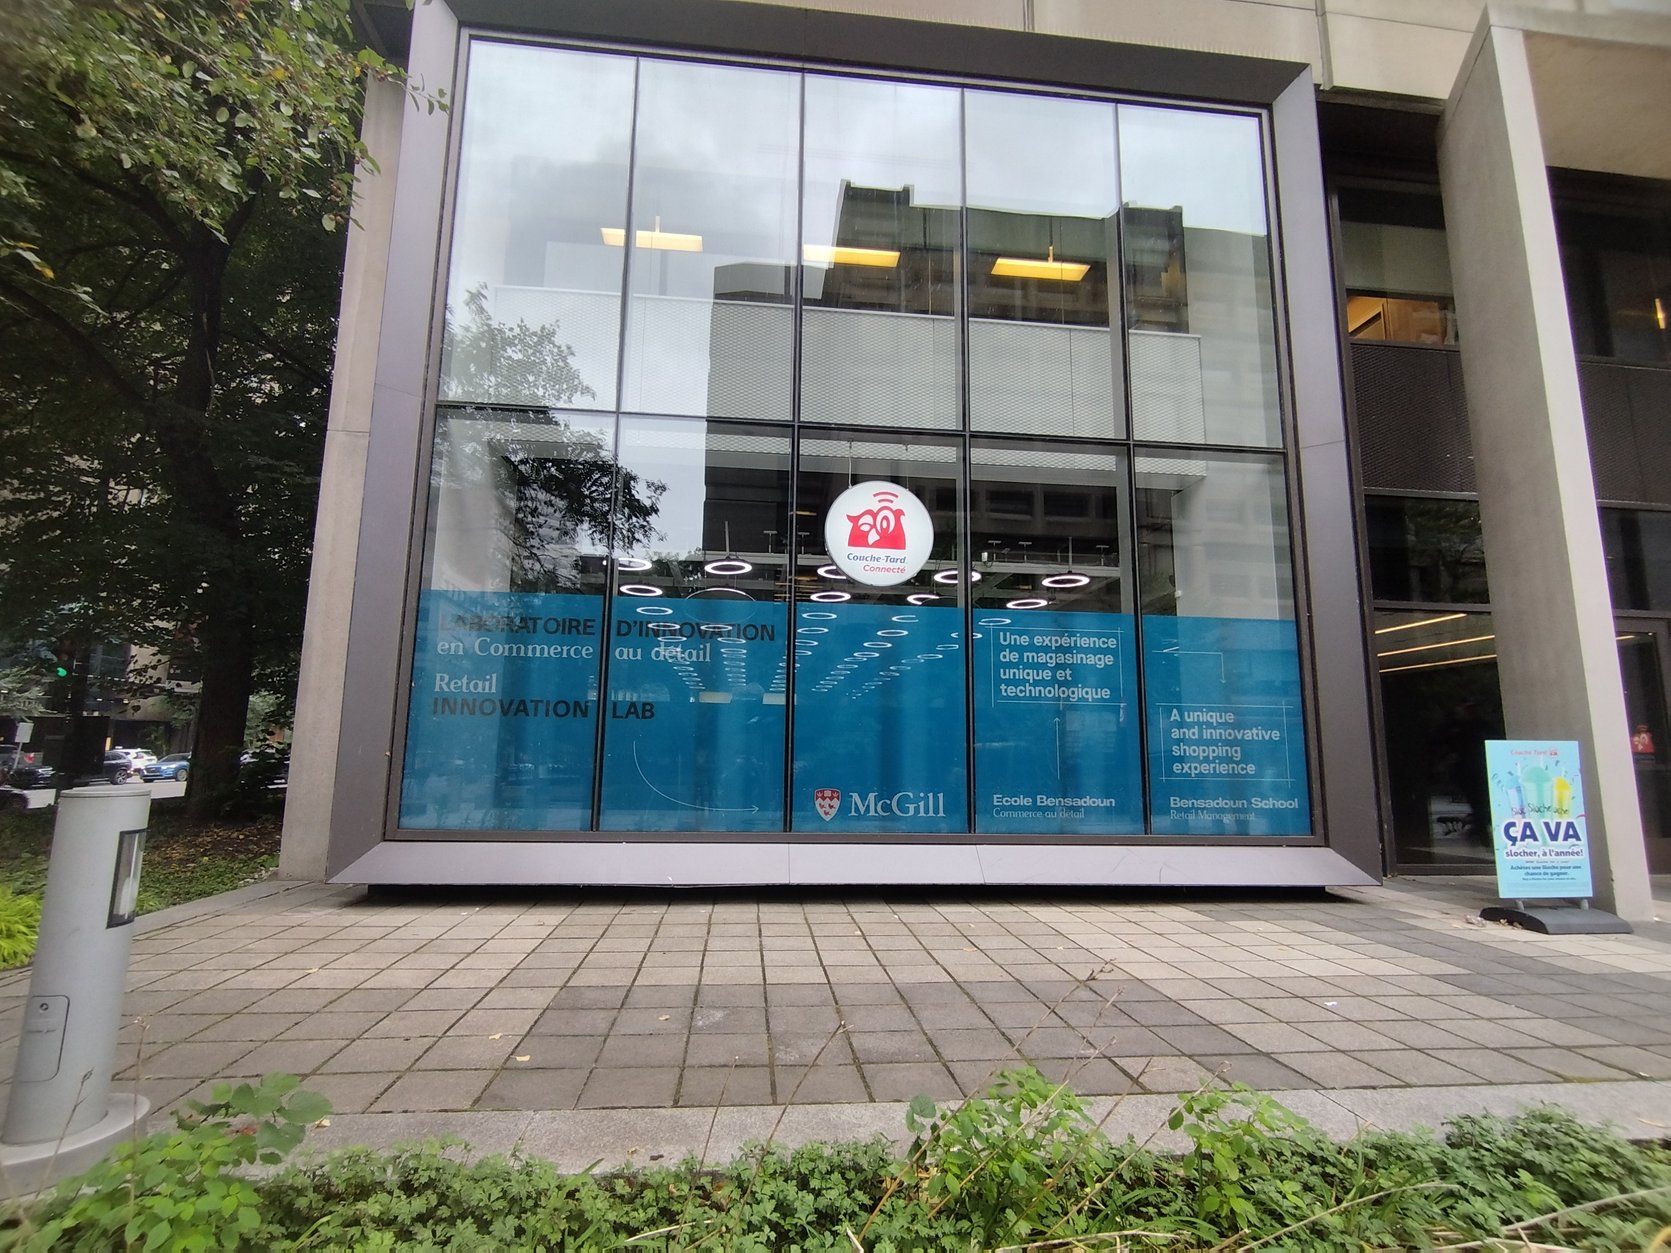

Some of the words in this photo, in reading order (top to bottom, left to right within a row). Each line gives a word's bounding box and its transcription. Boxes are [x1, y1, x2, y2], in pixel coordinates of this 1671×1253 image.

[847, 552, 907, 564] Couche-Tard
[863, 564, 906, 574] Connecté
[440, 613, 596, 636] LABORATOIRE
[1000, 632, 1030, 646] Une
[1033, 633, 1118, 649] expérience
[437, 641, 464, 655] en
[474, 637, 593, 659] Commerce
[615, 646, 642, 660] au
[651, 642, 711, 662] détail
[999, 649, 1019, 662] de
[1023, 650, 1114, 668] magasinage
[434, 673, 497, 693] Retail
[1000, 666, 1052, 683] unique
[1056, 668, 1072, 680] et
[1000, 683, 1111, 701] technologique
[433, 698, 589, 718] INNOVATION
[611, 702, 655, 719] LAB
[1170, 708, 1181, 721] A
[1184, 708, 1235, 726] unique
[1171, 725, 1199, 739] and
[1202, 725, 1281, 740] innovative
[1172, 742, 1241, 760] shopping
[1172, 760, 1256, 777] experience
[848, 792, 946, 817] McGill
[993, 794, 1032, 806] Ecole
[1036, 795, 1116, 807] Bensadoun
[1170, 796, 1247, 808] Bensadoun
[1251, 797, 1299, 809] School
[993, 807, 1043, 818] Commerce
[1059, 807, 1085, 819] détail
[1170, 809, 1196, 820] Retail
[1198, 810, 1255, 820] Management
[1503, 821, 1539, 847] ÇA
[1543, 821, 1582, 842] VA
[1505, 849, 1541, 858] slocher,
[1542, 849, 1548, 857] à
